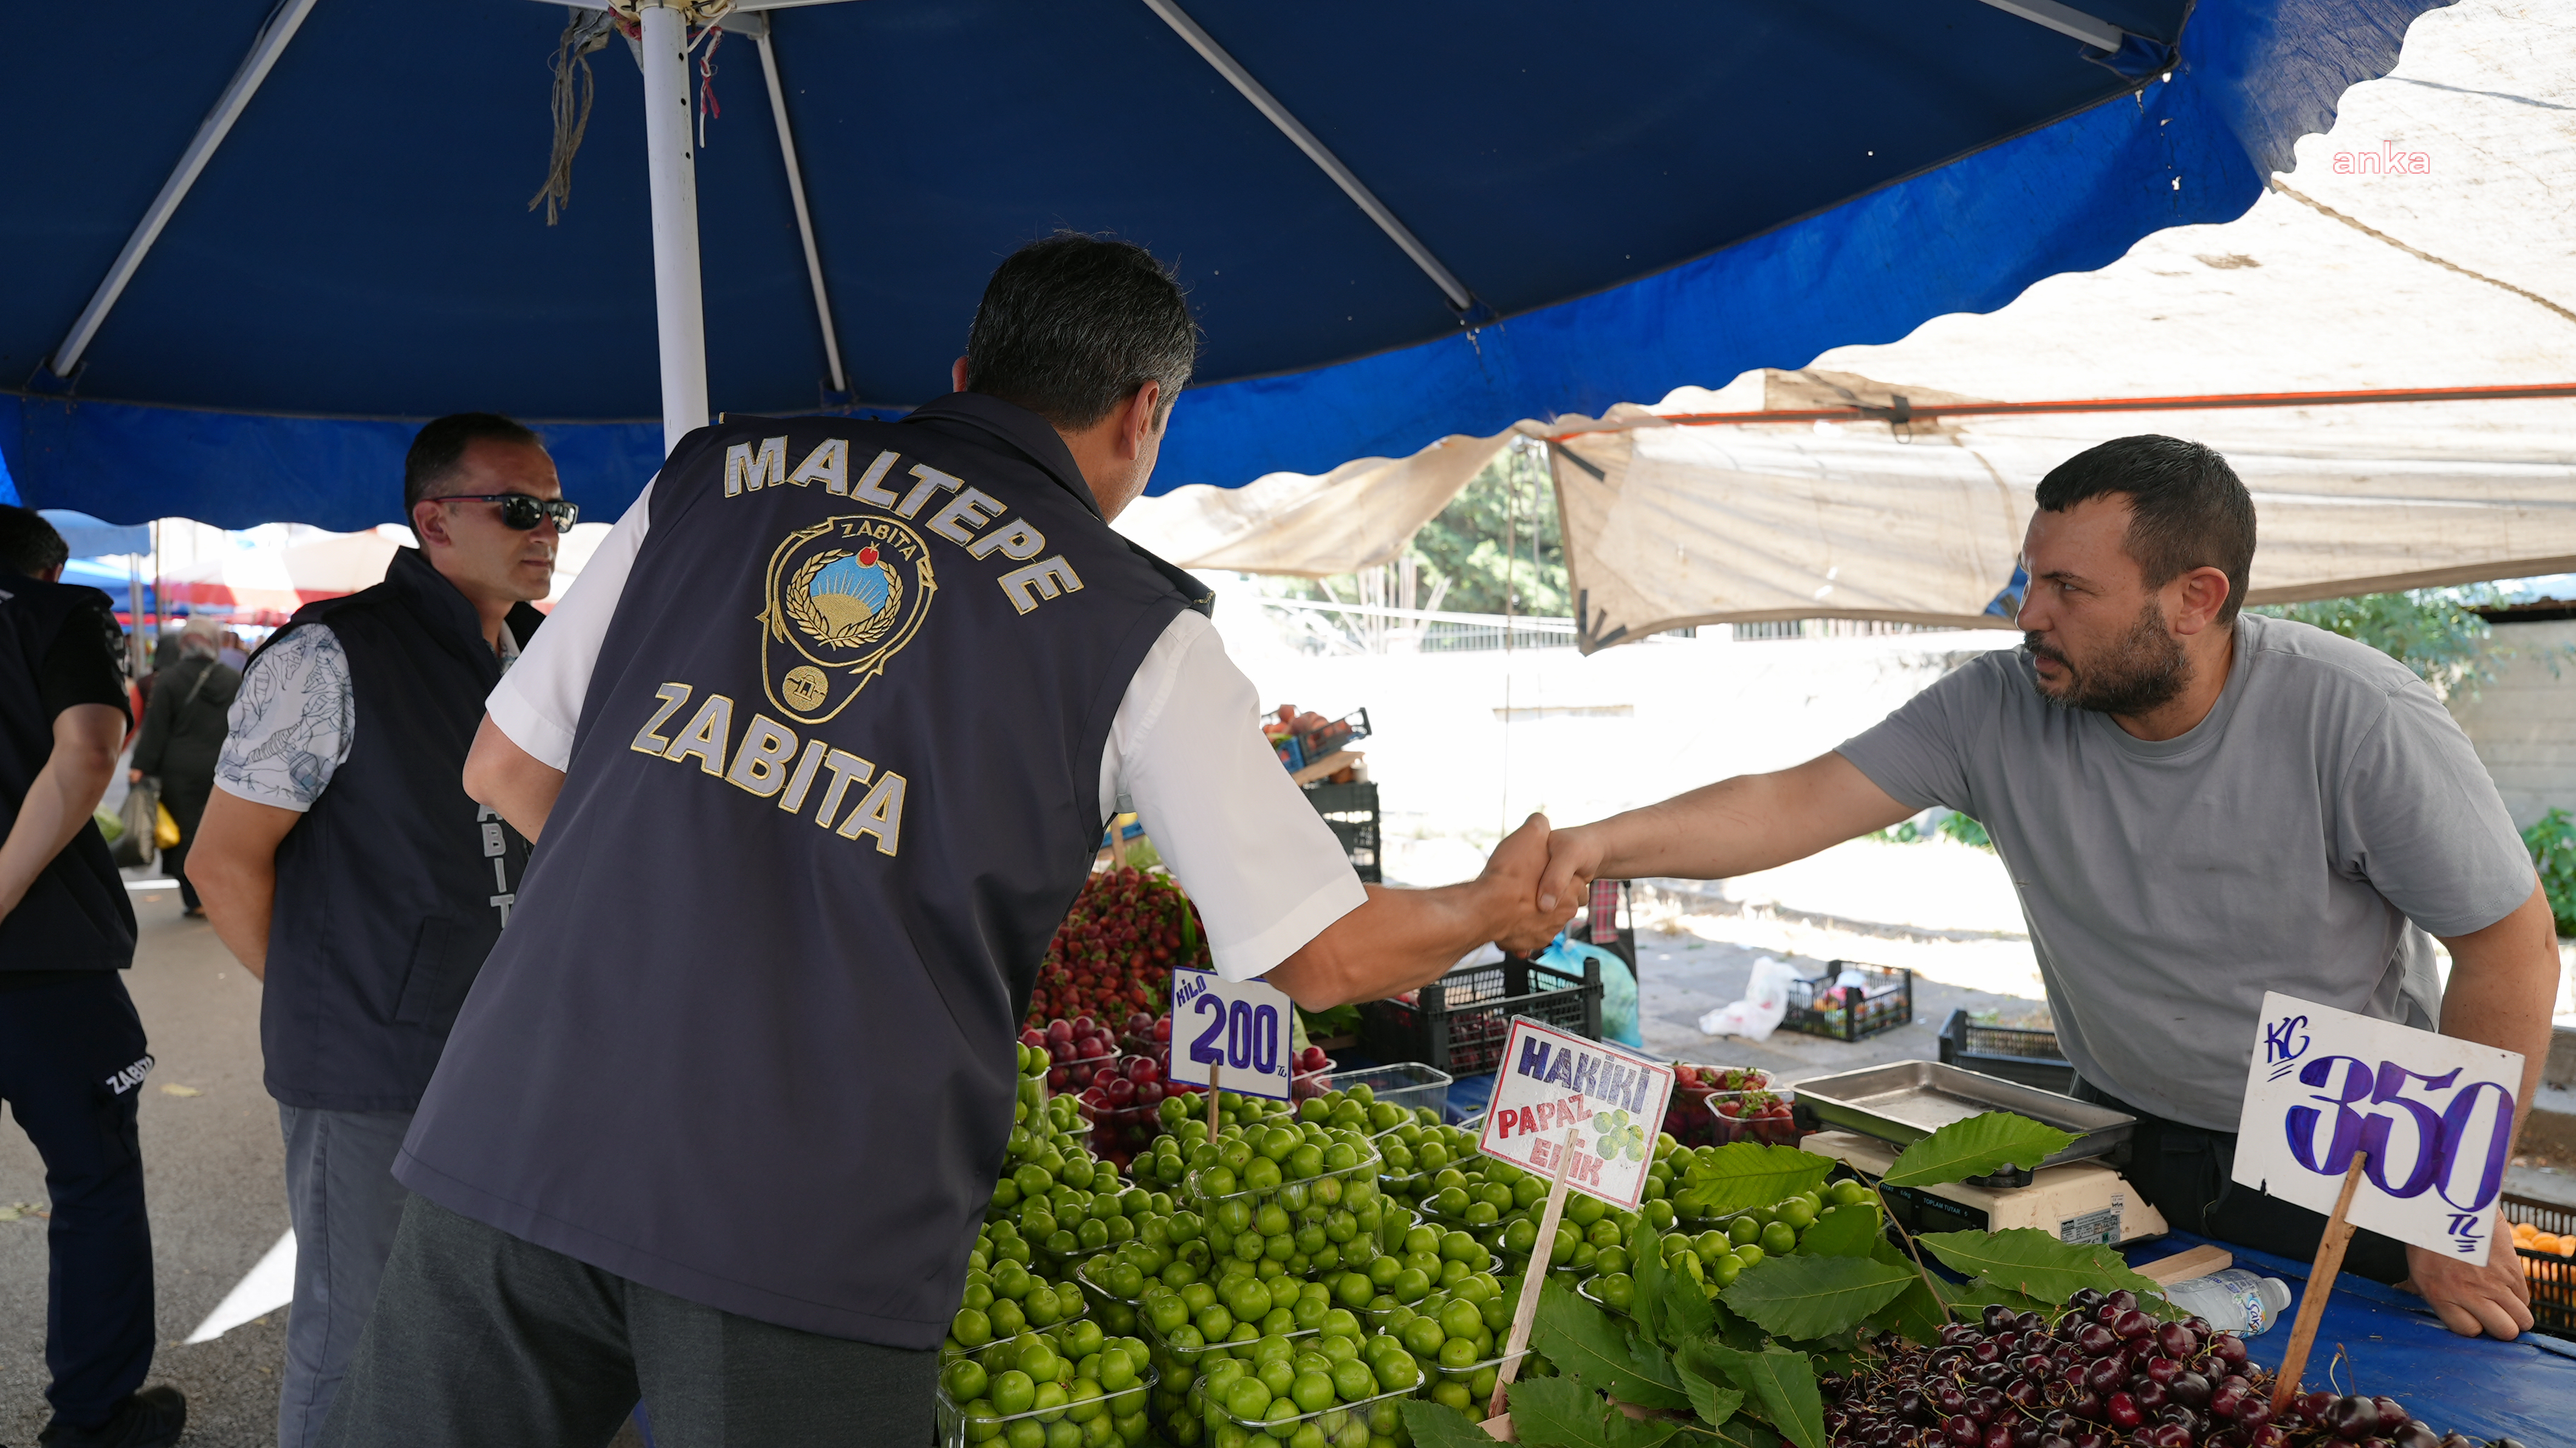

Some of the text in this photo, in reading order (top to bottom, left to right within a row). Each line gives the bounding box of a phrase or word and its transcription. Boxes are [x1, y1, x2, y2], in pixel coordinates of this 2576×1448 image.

[724, 434, 1084, 616] MALTEPE
[840, 520, 917, 562] ZABITA
[630, 681, 908, 857] ZABITA
[1176, 975, 1207, 1008] KİLO
[1190, 993, 1278, 1074] 200
[1276, 1065, 1287, 1078] TL
[1517, 1035, 1650, 1115] HAKİKİ
[1498, 1093, 1594, 1139] PAPAZ
[2285, 1055, 2515, 1213] 350
[1923, 1197, 1944, 1209] TOPLAM
[1944, 1204, 1961, 1215] TUTAR
[2446, 1214, 2485, 1238] TL
